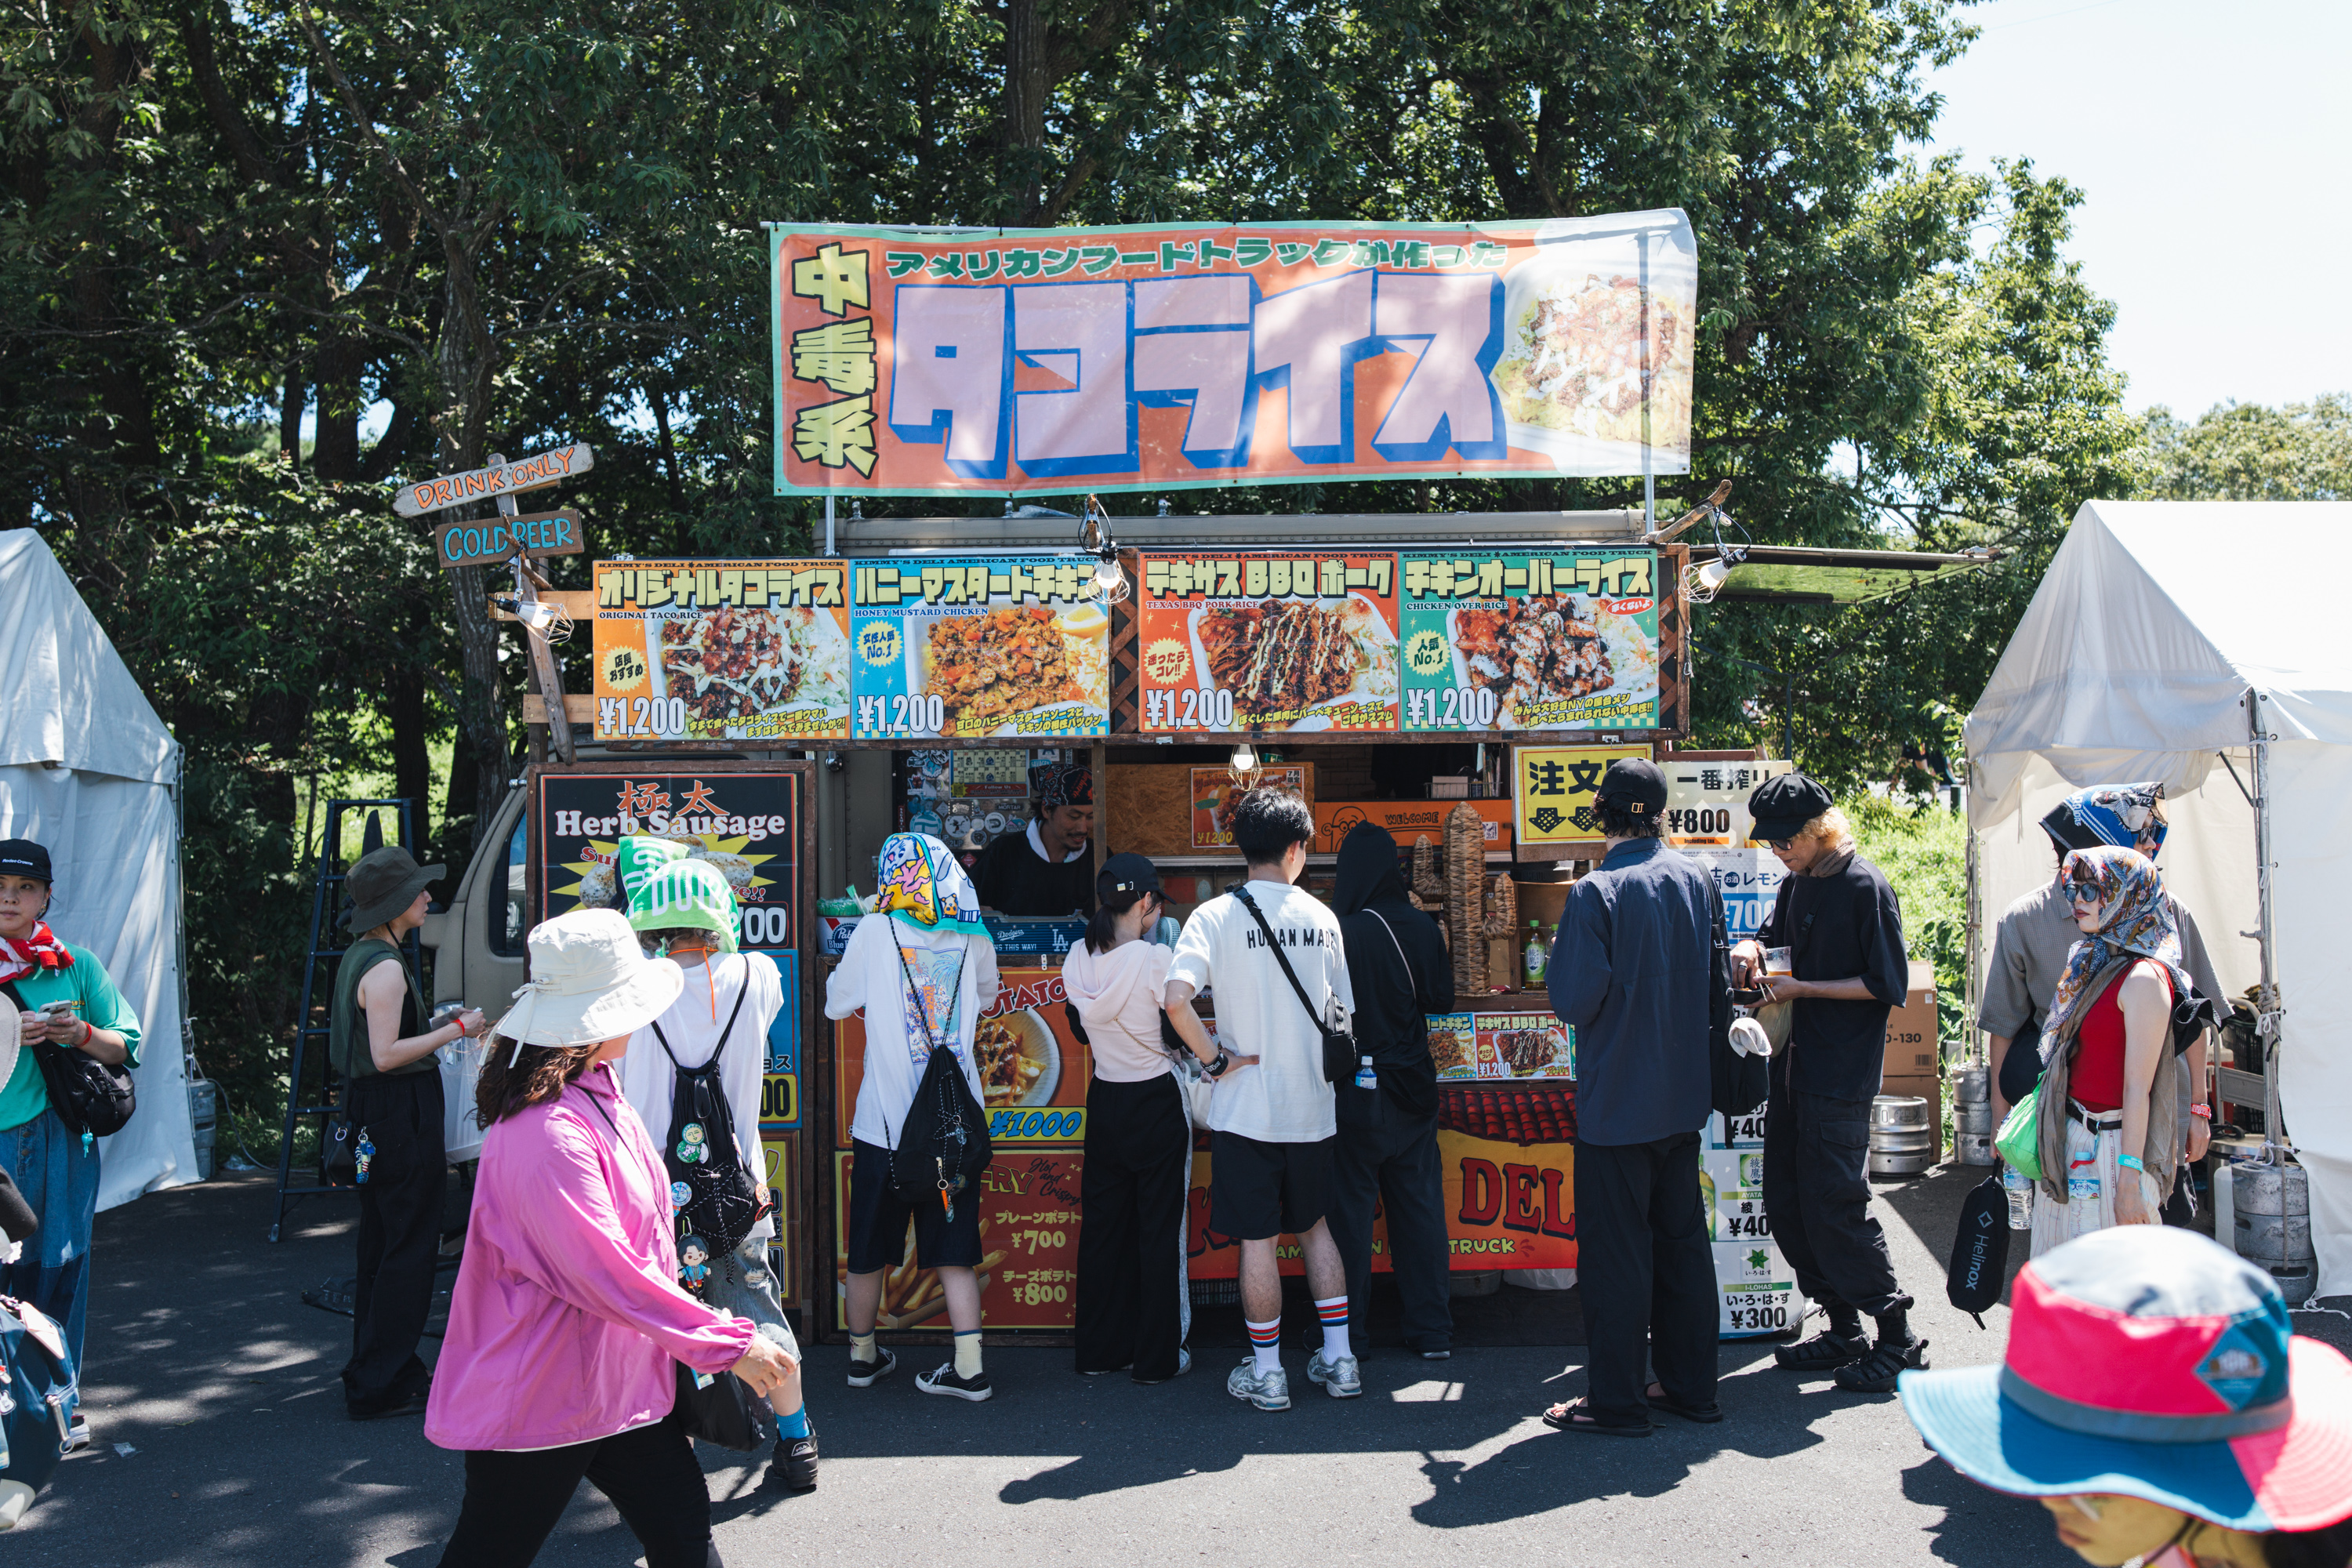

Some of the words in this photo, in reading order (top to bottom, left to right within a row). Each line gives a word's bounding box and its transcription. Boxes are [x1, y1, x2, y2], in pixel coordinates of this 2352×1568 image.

[886, 238, 1508, 280] アメリカンフードトラックが作った
[887, 267, 1508, 480] タコライス
[413, 470, 505, 509] DRINK
[511, 447, 575, 485] ONLY
[445, 526, 508, 561] COLD
[511, 517, 574, 549] BEER
[598, 568, 845, 609] オリジナルタコライス
[855, 564, 1103, 607] ハニーマスタードチキン
[1146, 560, 1243, 599] テキサス
[1246, 560, 1319, 598] BBQ
[1320, 559, 1394, 598] ポーク
[1405, 557, 1653, 600] チキンオーバーライス
[855, 608, 889, 617] HONEY
[1146, 601, 1180, 609] TEXAS
[1182, 601, 1203, 609] BBQ
[1406, 602, 1451, 611] CHICKEN
[1484, 601, 1508, 610] RICE
[1611, 599, 1651, 613] 辛くないよ
[615, 652, 632, 668] 店長
[867, 643, 891, 660] No.1
[1148, 651, 1185, 666] 迷ったら
[1414, 650, 1443, 667] No.1
[609, 663, 643, 682] おすすめ
[598, 696, 686, 739] ¥1,200
[857, 694, 944, 736] ¥1,200
[956, 706, 1083, 731] 甘口のハニーマスタードソースと
[1145, 688, 1233, 731] ¥1,200
[1406, 687, 1494, 730] ¥1,200
[1529, 758, 1620, 797] 注文
[1677, 768, 1769, 790] 一番搾り
[616, 779, 730, 818] 極太
[555, 810, 640, 837] Herb
[648, 810, 786, 841] Sausage
[1385, 811, 1439, 825] WELCOME
[1668, 808, 1730, 834] ¥800
[1197, 831, 1233, 844] ¥1200
[1744, 872, 1784, 886] レモン
[828, 939, 844, 949] Blue
[837, 928, 852, 939] Pab
[996, 929, 1024, 941] Dodgers
[1052, 929, 1069, 952] LA
[1247, 928, 1297, 949] HUAN
[1476, 1017, 1512, 1031] テキサス
[1512, 1016, 1537, 1030] BBQ
[1886, 1033, 1922, 1044] 0-130
[764, 1054, 792, 1071] ョス
[1479, 1062, 1512, 1077] ¥1,200
[763, 1077, 791, 1117] 00
[988, 1110, 1082, 1138] ¥1000
[1732, 1117, 1764, 1139] ¥40
[1029, 1157, 1059, 1173] Hot
[1040, 1173, 1065, 1185] and
[1040, 1181, 1082, 1207] Crispy
[1458, 1157, 1577, 1241] DEL
[996, 1210, 1082, 1225] プレーンポテト
[1728, 1215, 1771, 1236] ¥40
[1012, 1229, 1067, 1255] ¥700
[1449, 1237, 1516, 1255] TRUCK
[1965, 1233, 1990, 1291] Helinox
[1002, 1269, 1076, 1283] チーズポテト
[1013, 1283, 1068, 1305] ¥800
[1730, 1306, 1787, 1330] ¥300
